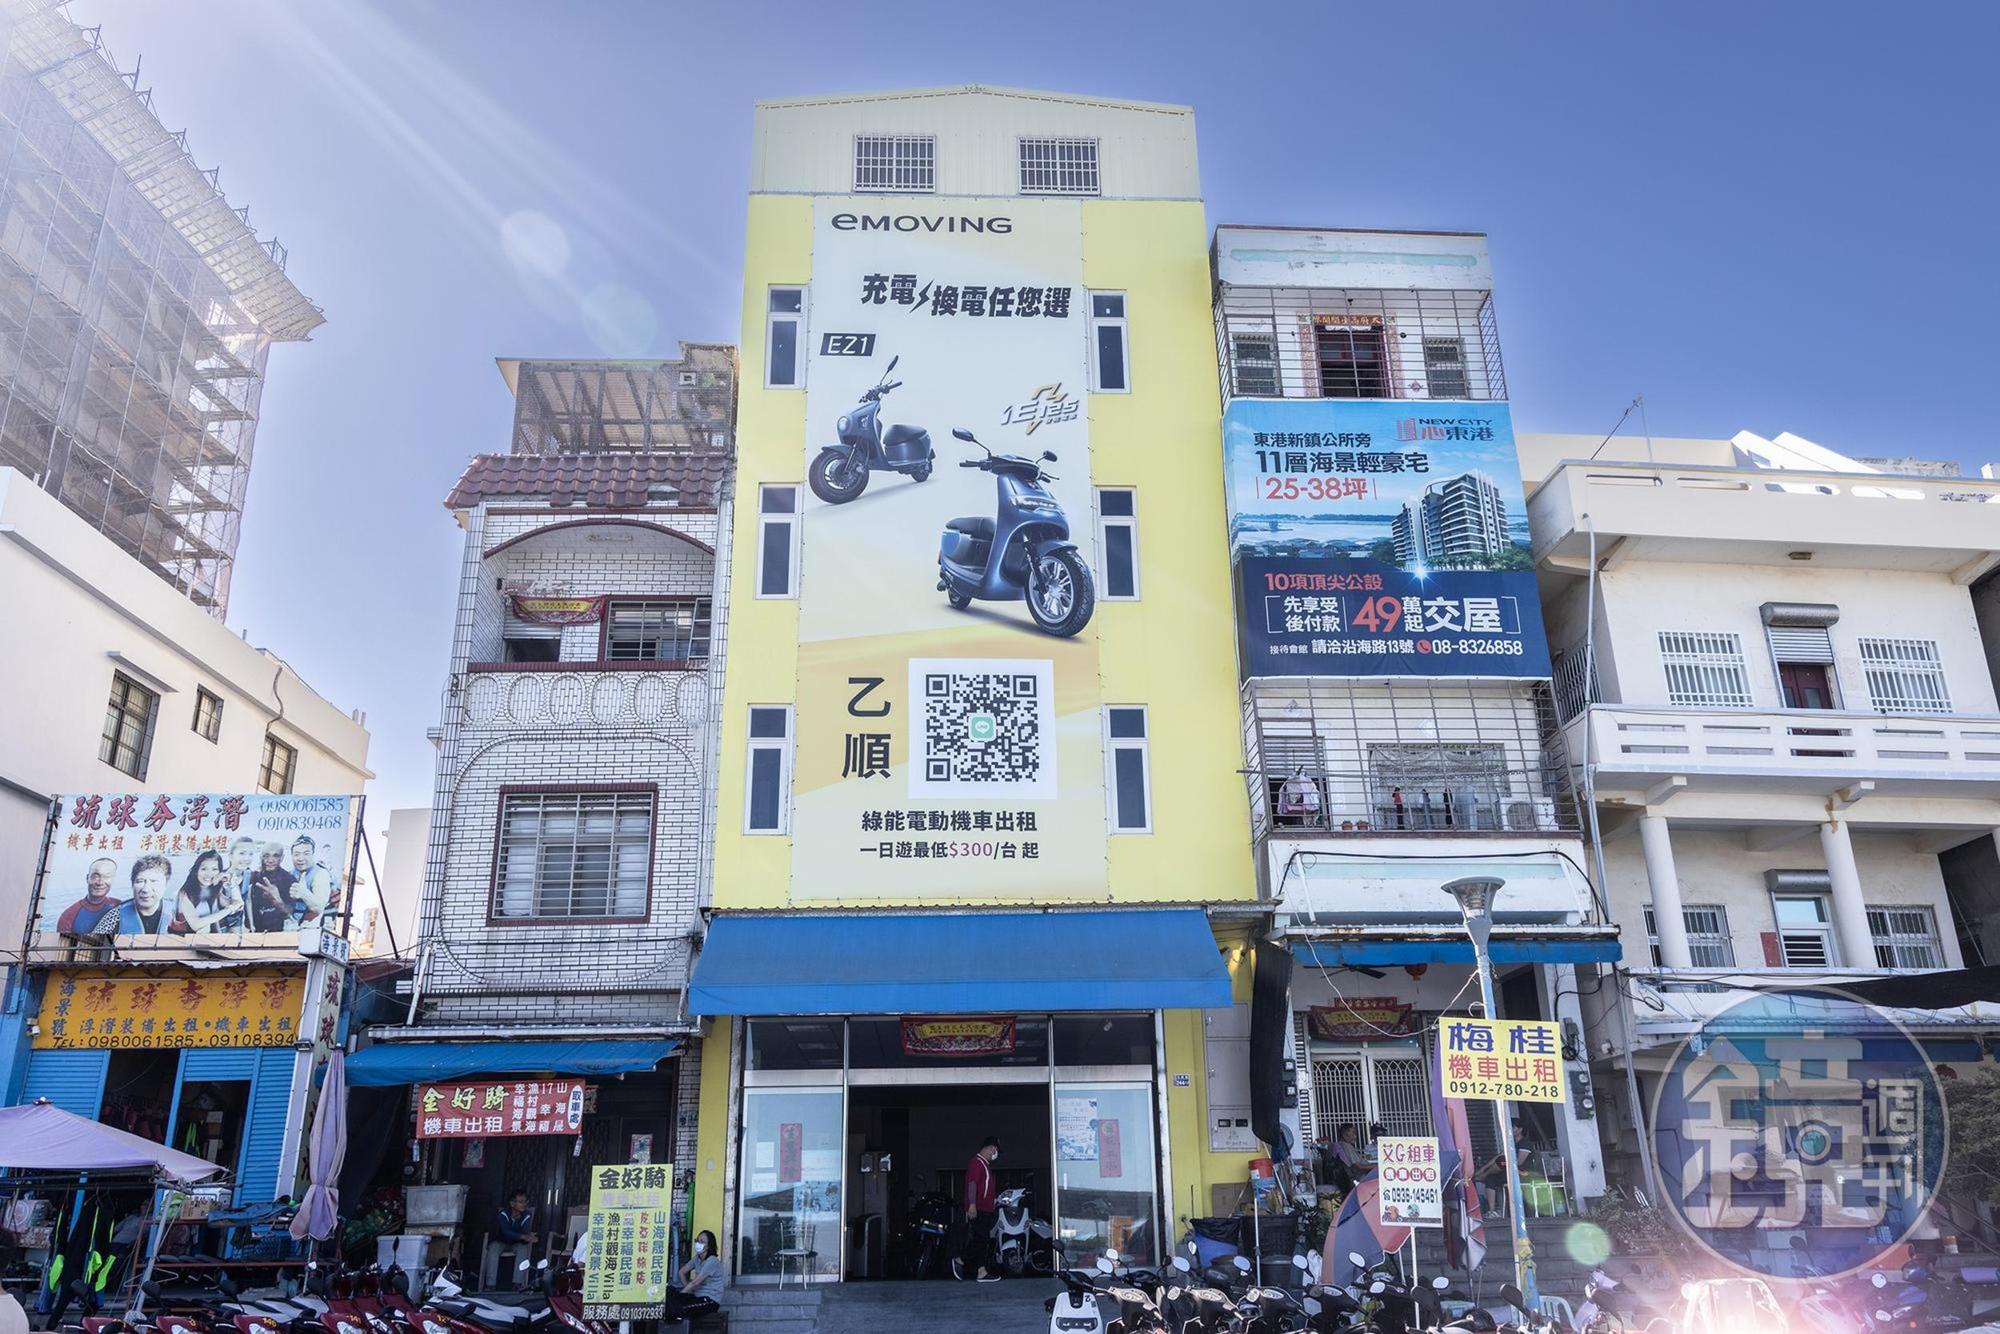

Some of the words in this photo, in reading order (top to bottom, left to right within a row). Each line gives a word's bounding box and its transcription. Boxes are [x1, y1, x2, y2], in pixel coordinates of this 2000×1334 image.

[831, 213, 1013, 234] eMOVING
[861, 273, 918, 305] 充電
[931, 285, 1071, 319] 換電任您選
[827, 336, 869, 355] EZ1
[1418, 418, 1455, 426] NEW
[1254, 432, 1371, 449] 東港新鎮公所旁
[1255, 450, 1429, 474] 11層海景輕豪宅
[1265, 477, 1368, 500] 25-38坪
[1264, 572, 1383, 592] 10項頂尖公設
[1284, 596, 1339, 614] 先享受
[1285, 615, 1341, 633] 後付款
[1311, 639, 1415, 655] 請洽沿海路13號
[1432, 639, 1523, 655] 08-8326858
[841, 677, 892, 780] 乙順
[260, 798, 344, 813] 0980061585
[257, 815, 342, 830] 0910839468
[861, 810, 1038, 832] 綠能電動機車出租
[67, 833, 124, 850] 機車出租
[1448, 1022, 1556, 1055] 梅桂
[1448, 1054, 1557, 1083] 機車出租
[422, 1084, 510, 1113] 金好騎
[1450, 1081, 1559, 1098] 0912-780-218
[423, 1116, 503, 1135] 機車出租
[598, 1167, 666, 1190] 金好騎
[583, 1305, 620, 1320] 服務處
